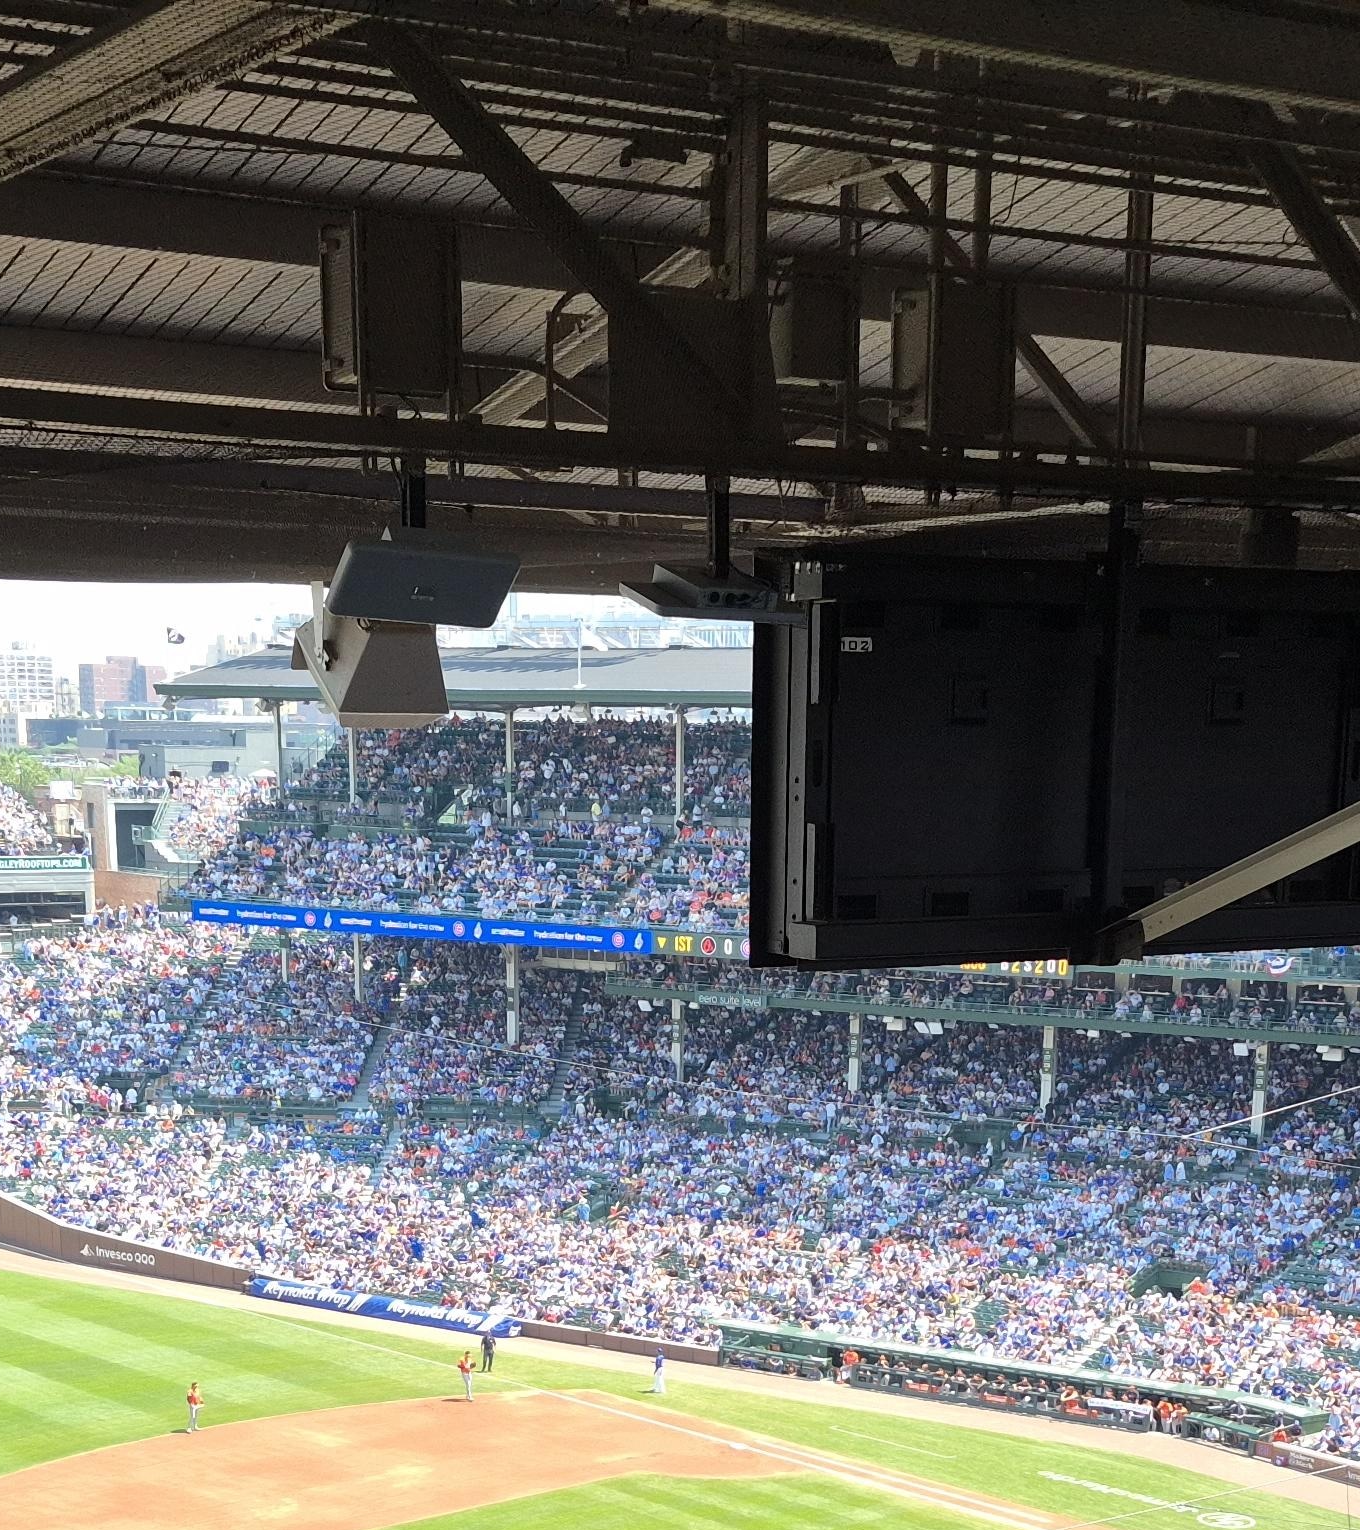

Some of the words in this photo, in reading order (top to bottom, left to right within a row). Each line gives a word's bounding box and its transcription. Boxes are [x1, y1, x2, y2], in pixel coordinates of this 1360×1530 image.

[842, 640, 869, 651] 102
[674, 935, 693, 952] 1ST
[724, 938, 732, 955] 0
[1034, 960, 1044, 975] 2
[720, 995, 740, 1006] suite
[742, 996, 761, 1007] level
[96, 1245, 133, 1262] Invesco
[134, 1252, 156, 1266] QQQ
[262, 1281, 317, 1300] Reynolds
[317, 1288, 351, 1308] Wrap
[387, 1299, 446, 1320] Reynolds
[446, 1308, 483, 1329] Wrap
